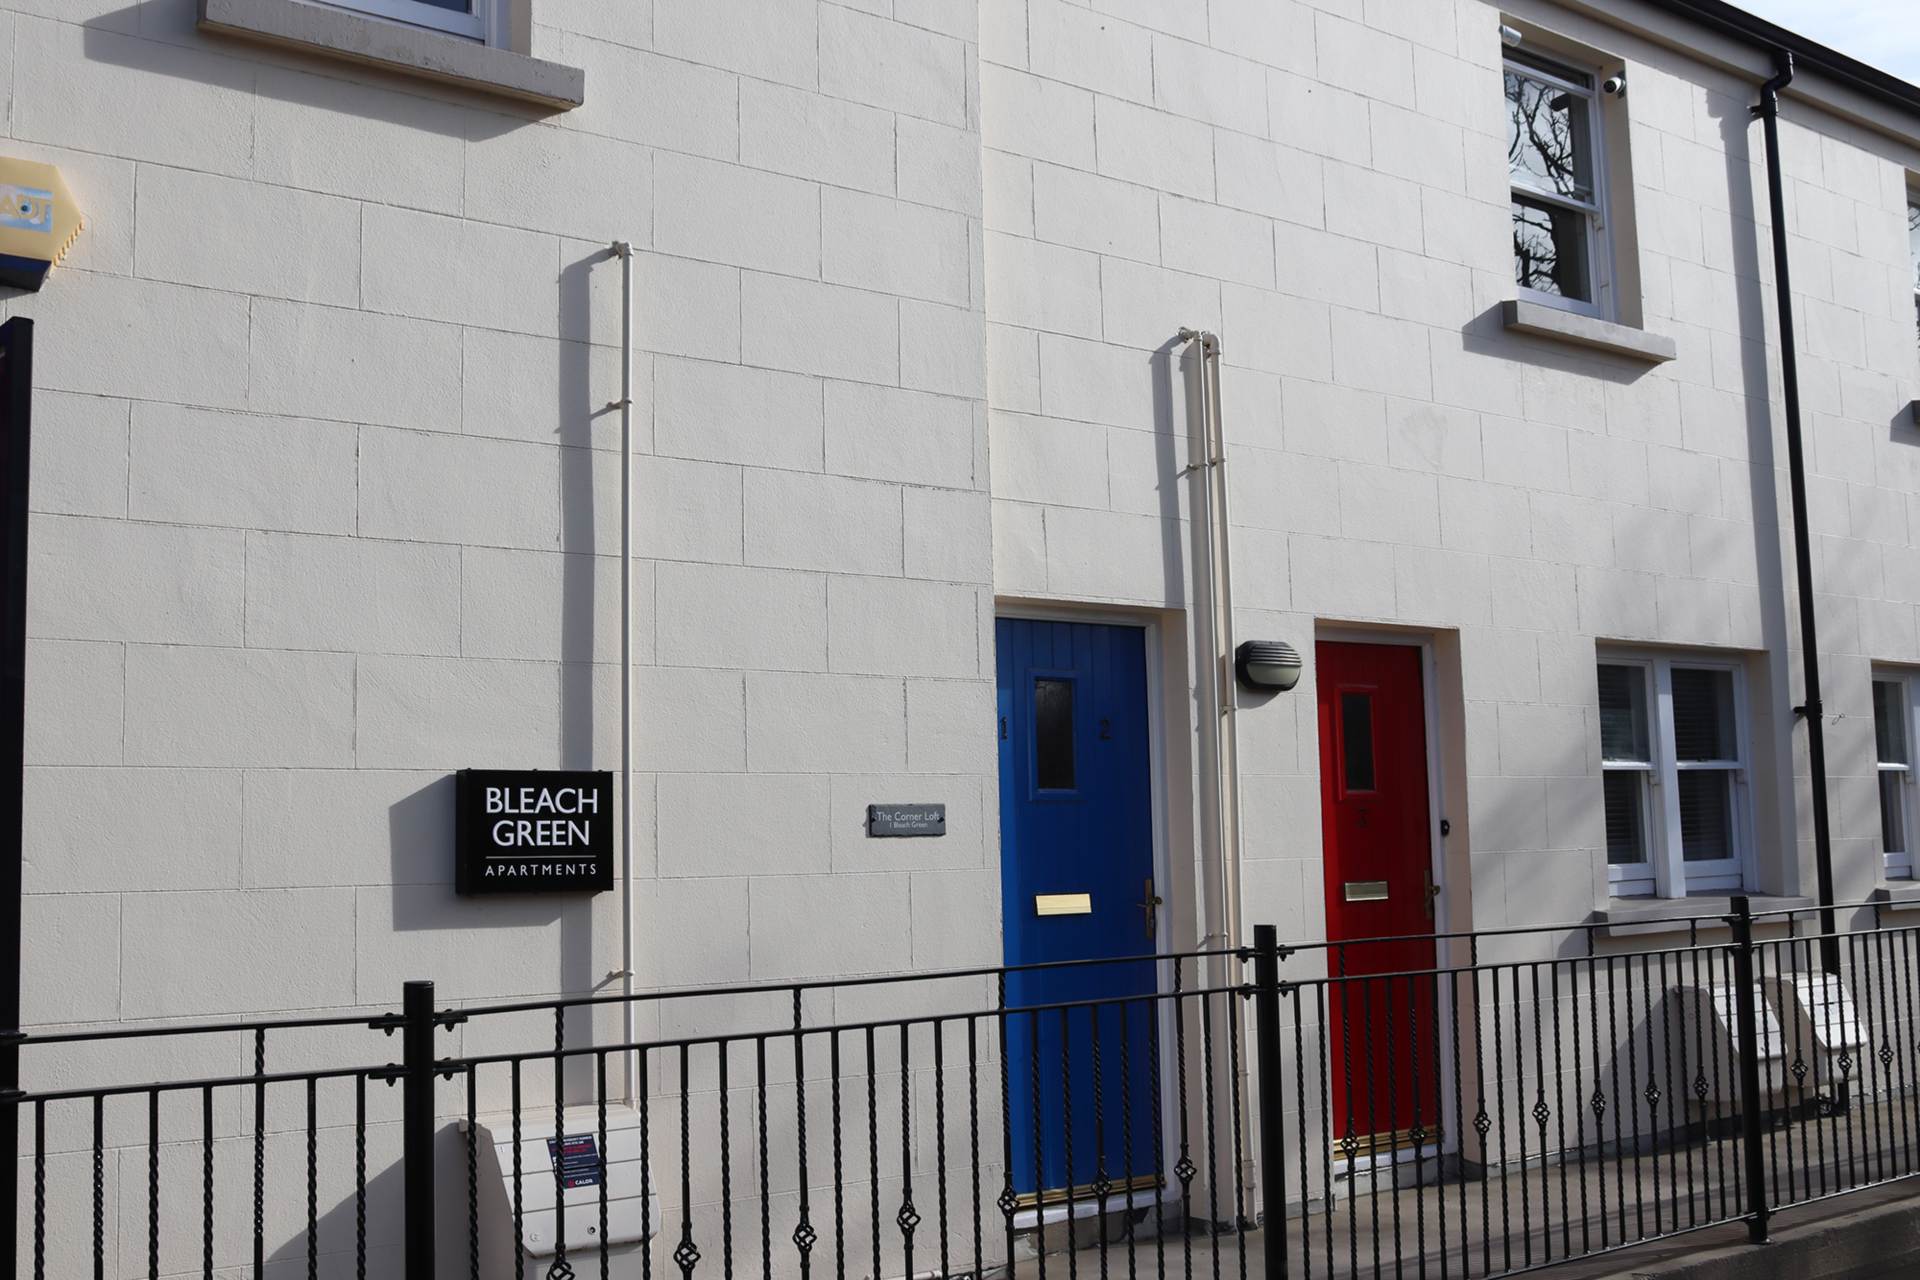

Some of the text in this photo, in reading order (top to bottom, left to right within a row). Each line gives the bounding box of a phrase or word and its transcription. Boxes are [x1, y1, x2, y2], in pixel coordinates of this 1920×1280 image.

[486, 787, 598, 814] BLEACH
[877, 811, 940, 821] The Corner Loft
[492, 820, 590, 847] GREEN
[485, 863, 597, 877] APARTMENTS
